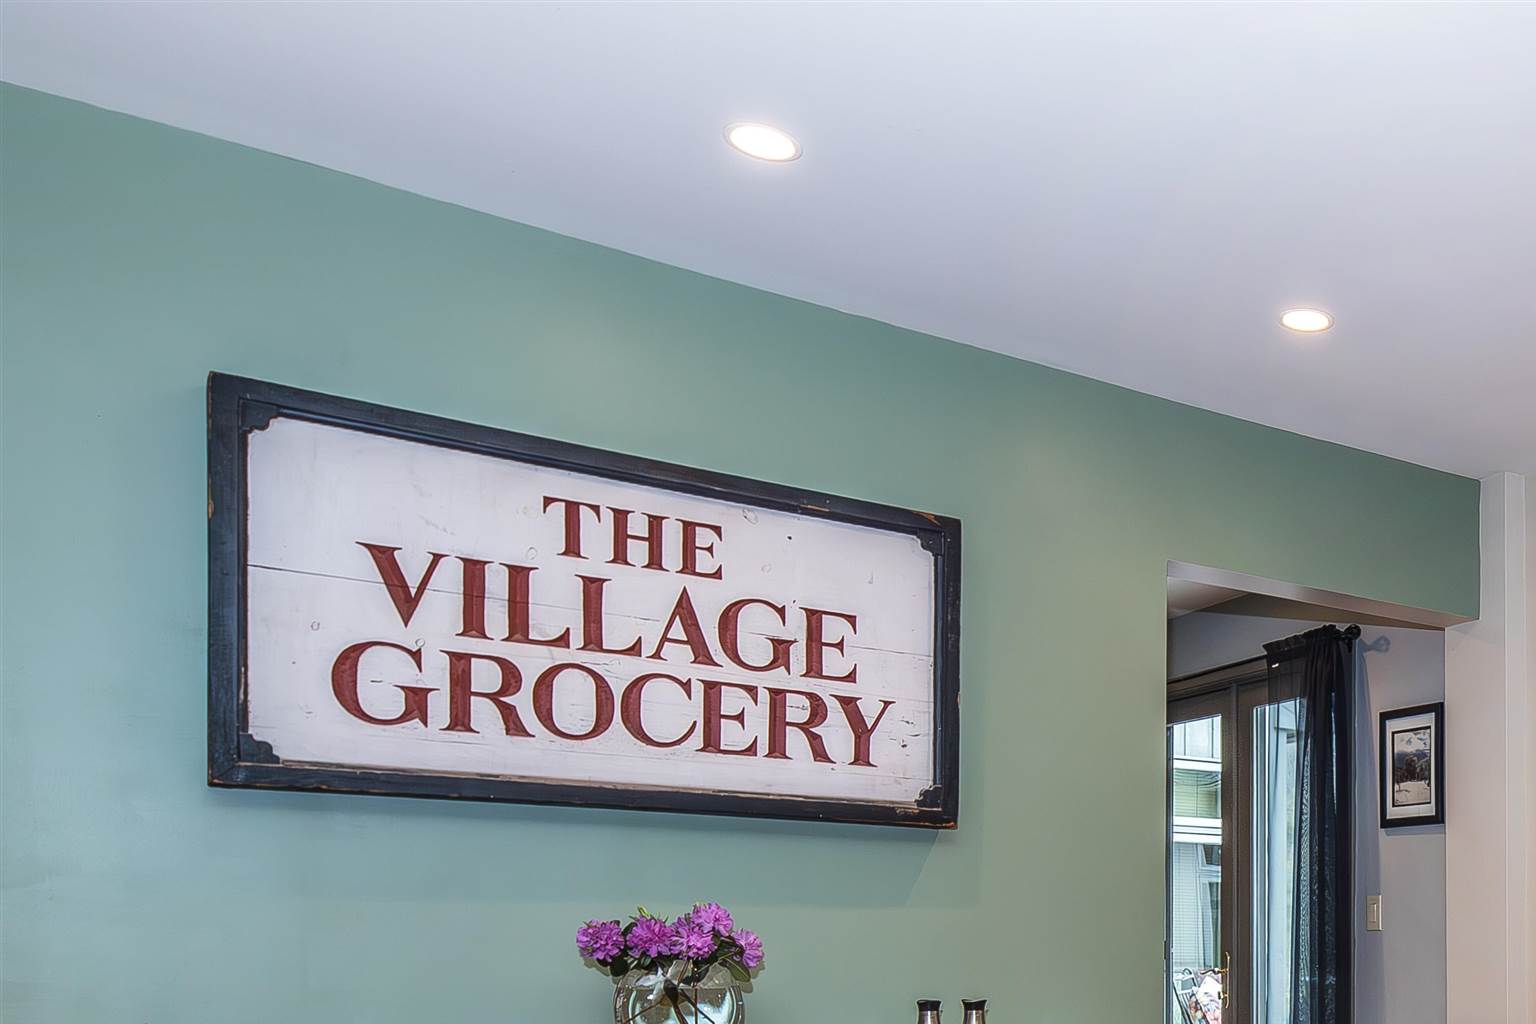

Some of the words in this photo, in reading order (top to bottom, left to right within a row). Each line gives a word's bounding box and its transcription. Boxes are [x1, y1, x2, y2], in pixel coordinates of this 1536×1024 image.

[541, 495, 724, 580] THE
[355, 540, 858, 684] VILLAGE
[330, 640, 897, 768] GROCERY
